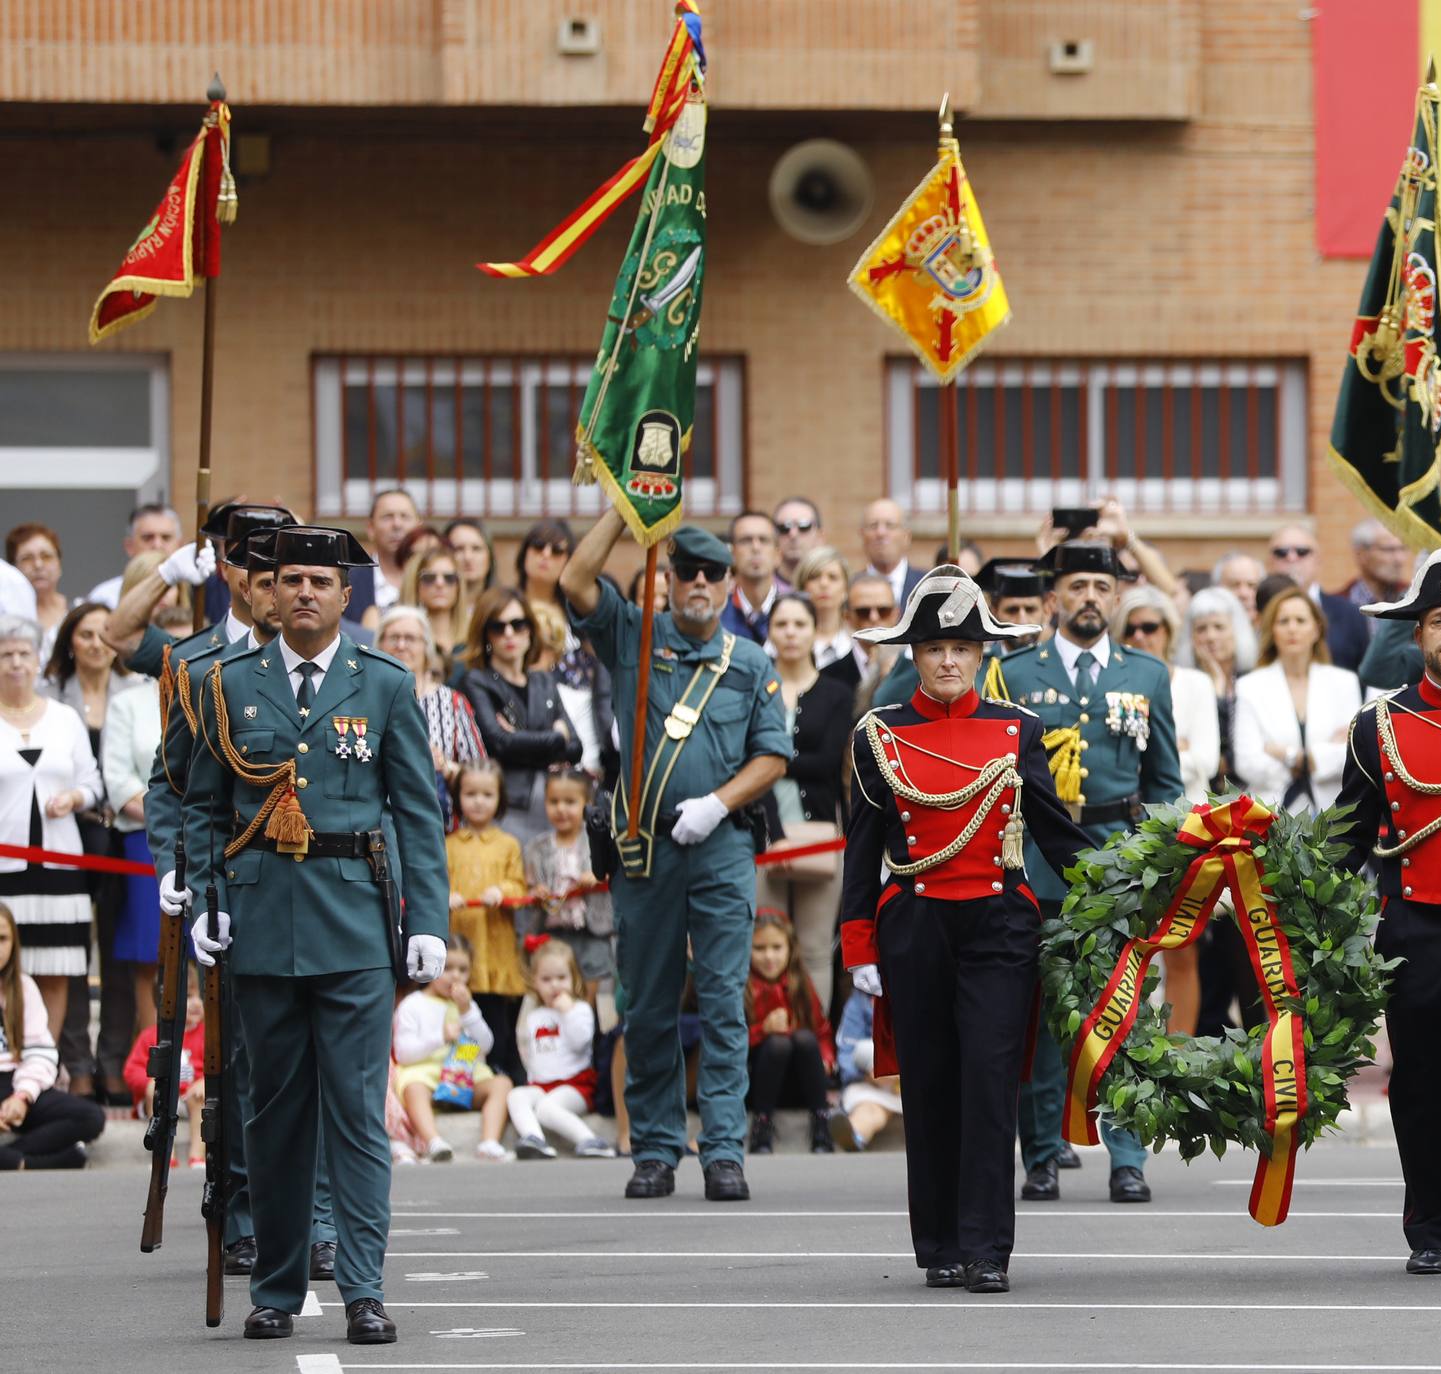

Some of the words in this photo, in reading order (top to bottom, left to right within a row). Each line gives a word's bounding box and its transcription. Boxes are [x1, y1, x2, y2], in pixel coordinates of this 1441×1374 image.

[1093, 947, 1144, 1042] GUARDIA
[1168, 896, 1208, 938] CIVIL
[1273, 1060, 1298, 1120] CIVIL
